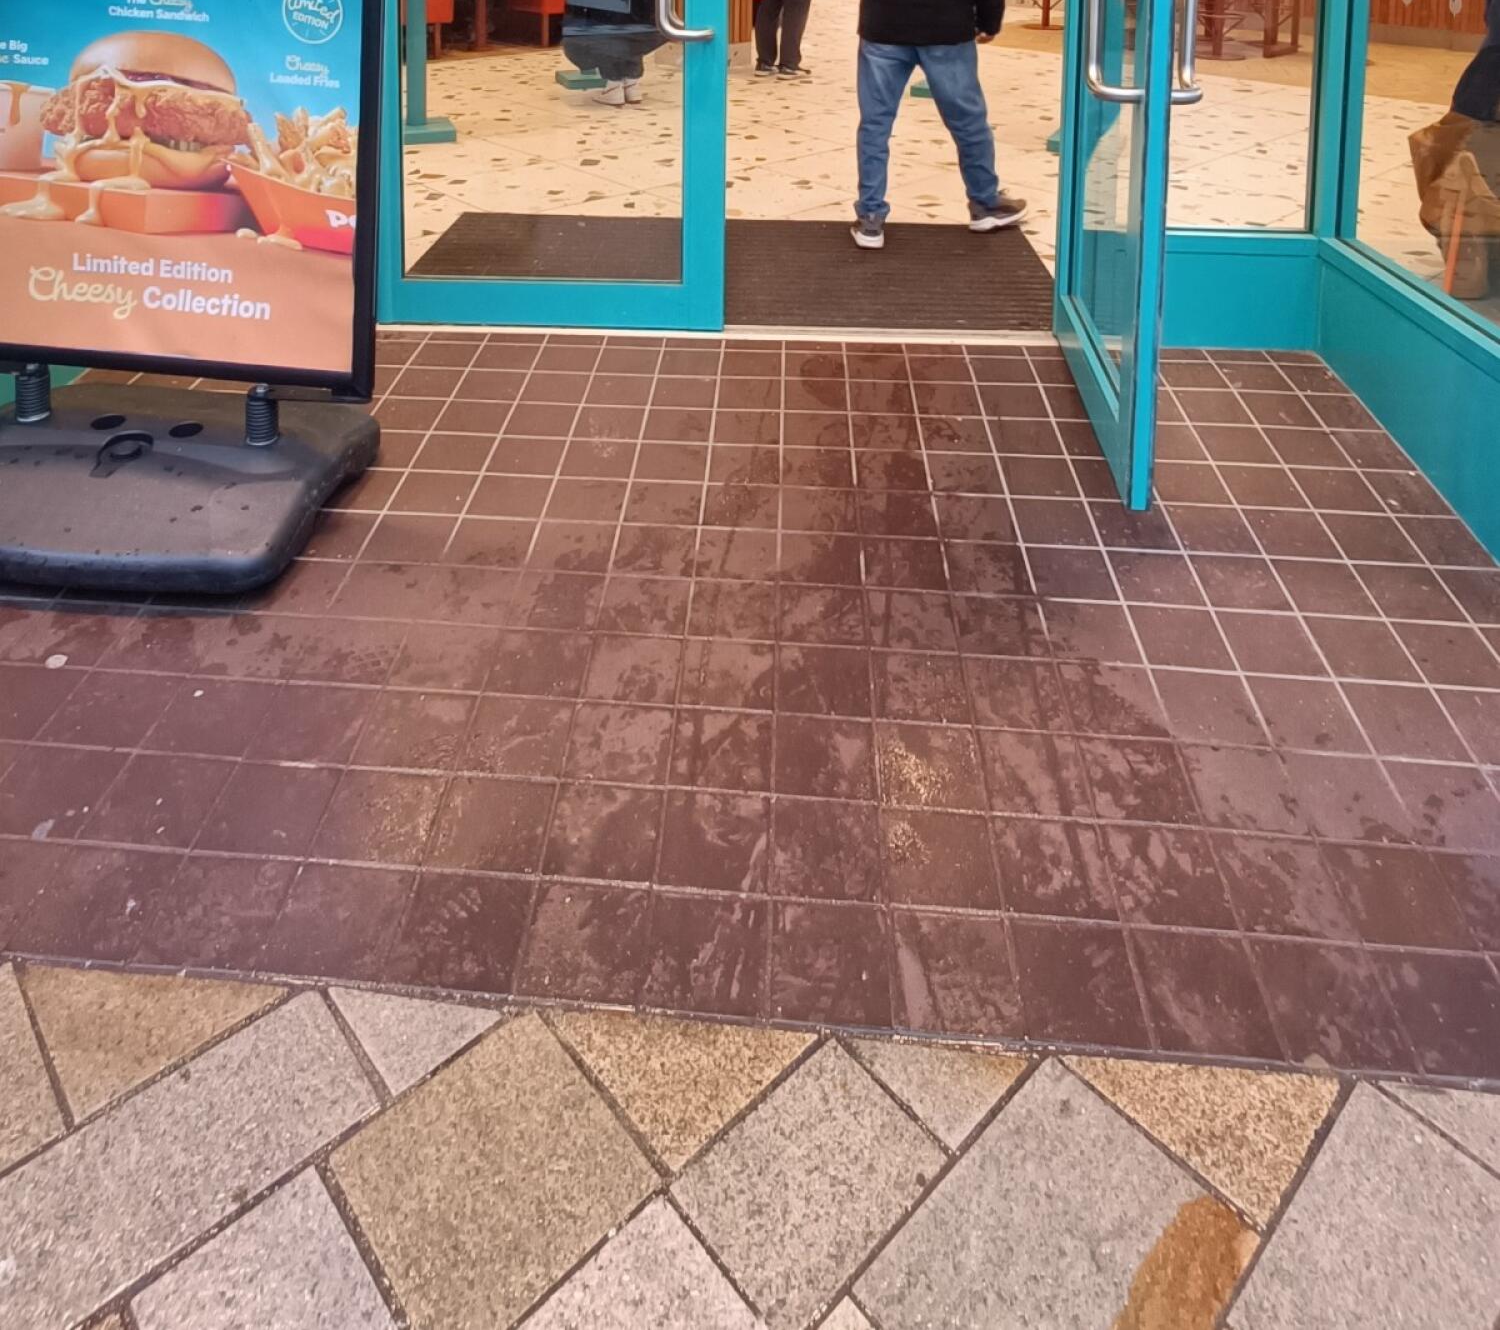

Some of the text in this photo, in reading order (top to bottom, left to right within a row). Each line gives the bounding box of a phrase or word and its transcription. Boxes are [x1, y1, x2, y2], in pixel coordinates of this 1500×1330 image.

[108, 5, 210, 22] Chicken Sandwich
[292, 10, 330, 30] EDITION
[9, 39, 29, 53] Big
[13, 53, 50, 66] Sauce
[269, 72, 341, 89] Loaded Fries
[71, 252, 234, 284] Limited Edition
[28, 264, 272, 321] Cheesy Collection
